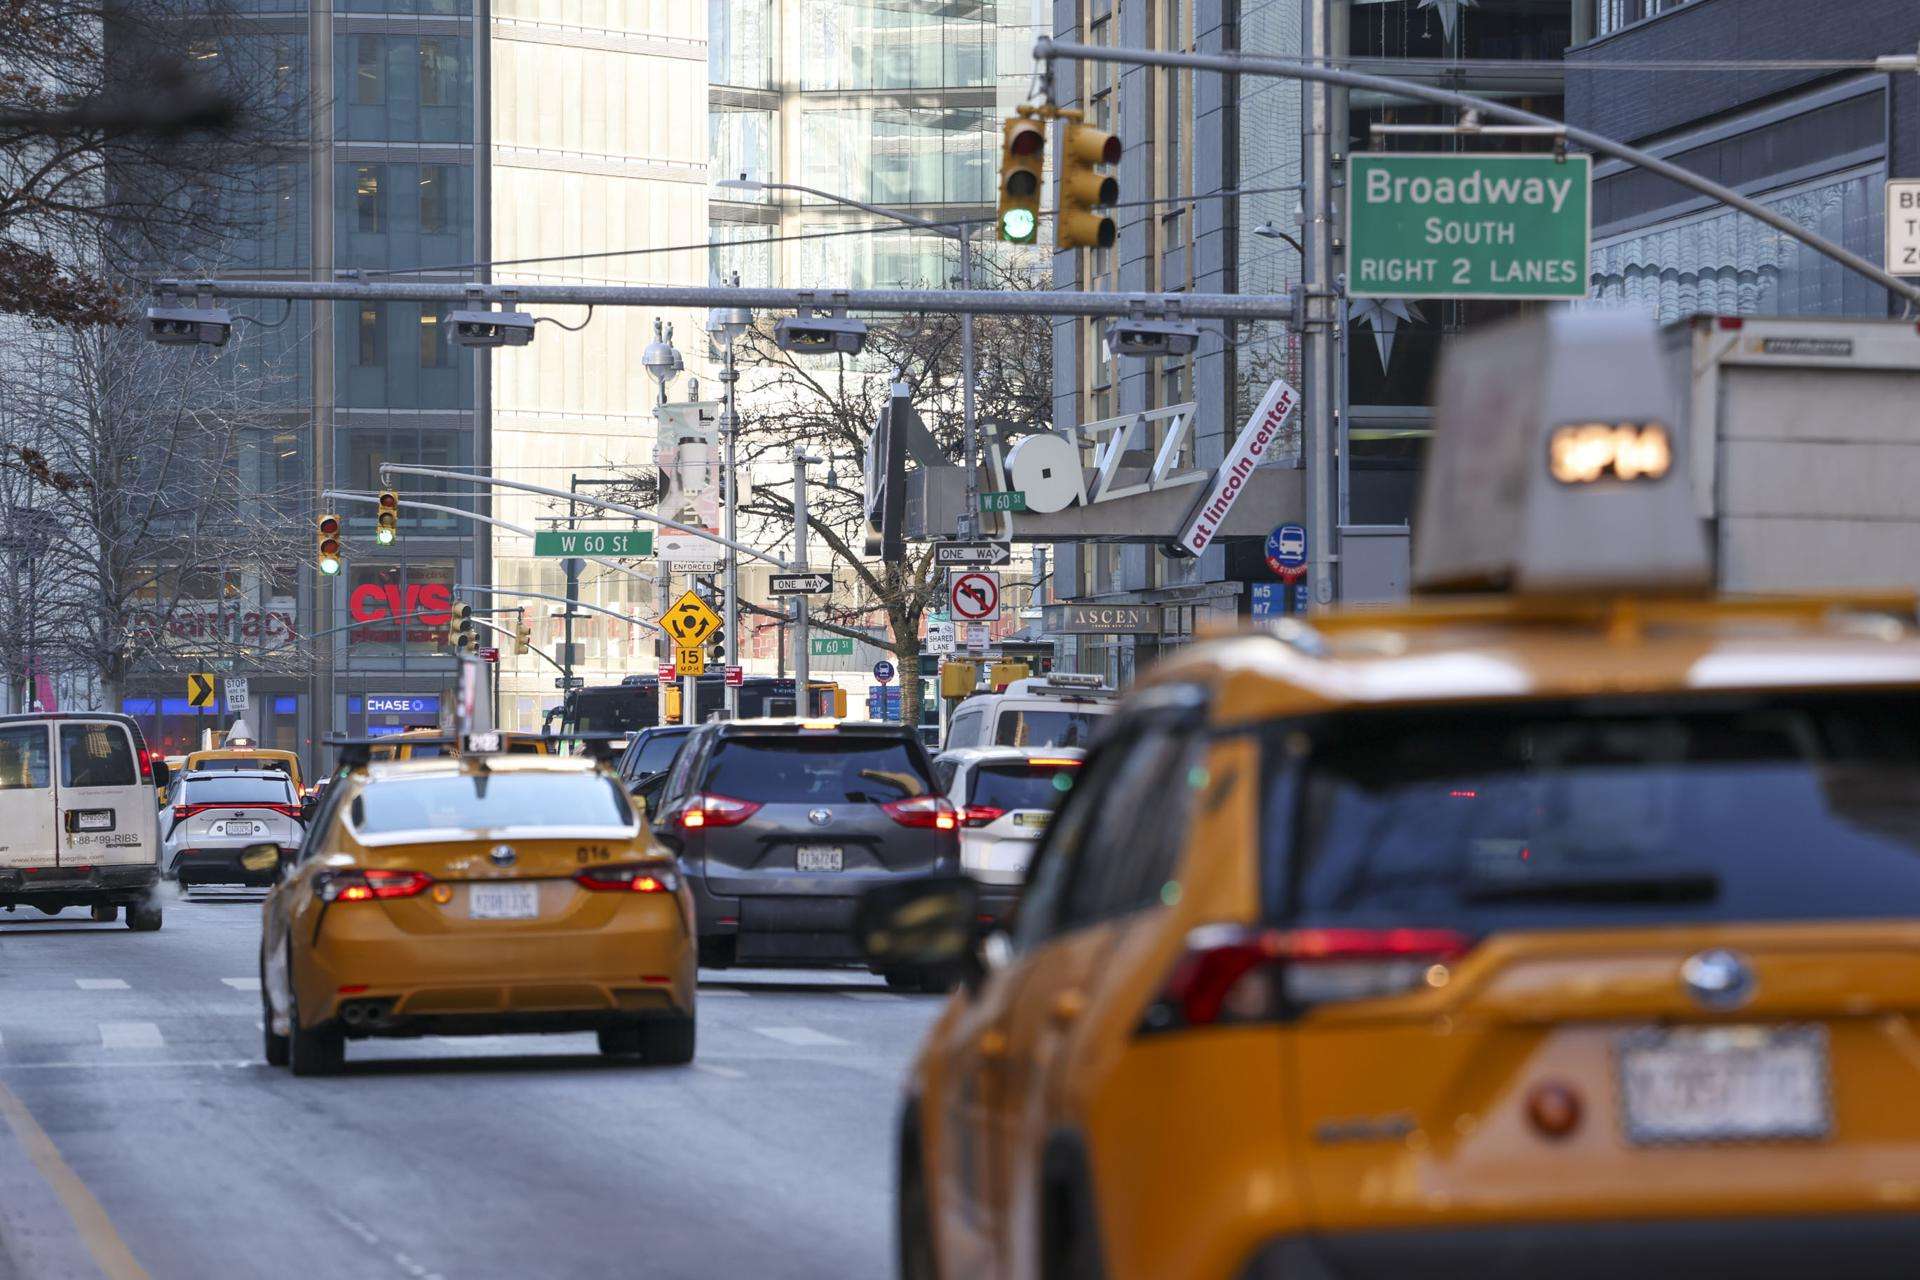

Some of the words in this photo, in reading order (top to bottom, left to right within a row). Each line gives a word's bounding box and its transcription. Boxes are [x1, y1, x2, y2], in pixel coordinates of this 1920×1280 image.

[1366, 169, 1572, 213] Broadway
[1425, 217, 1515, 244] SOUTH
[1360, 259, 1438, 281] RIGHT
[1452, 258, 1471, 284] 2
[1490, 260, 1577, 283] LANES
[1192, 524, 1211, 549] at
[1203, 457, 1254, 526] lincoln
[1249, 390, 1291, 456] center
[984, 497, 992, 509] W
[997, 496, 1010, 509] 60
[561, 537, 575, 551] W
[584, 536, 605, 551] 60
[612, 535, 628, 551] St
[942, 550, 964, 559] ONE
[977, 549, 1000, 558] WAY
[778, 581, 796, 589] ONE
[805, 579, 824, 588] WAY
[1254, 586, 1271, 598] M5
[351, 583, 453, 625] CVS
[1254, 602, 1270, 614] M7
[815, 643, 823, 653] W
[826, 642, 838, 653] 60
[680, 650, 699, 664] 15
[226, 679, 246, 688] STOP
[229, 695, 245, 703] RED
[367, 700, 410, 711] CHASE
